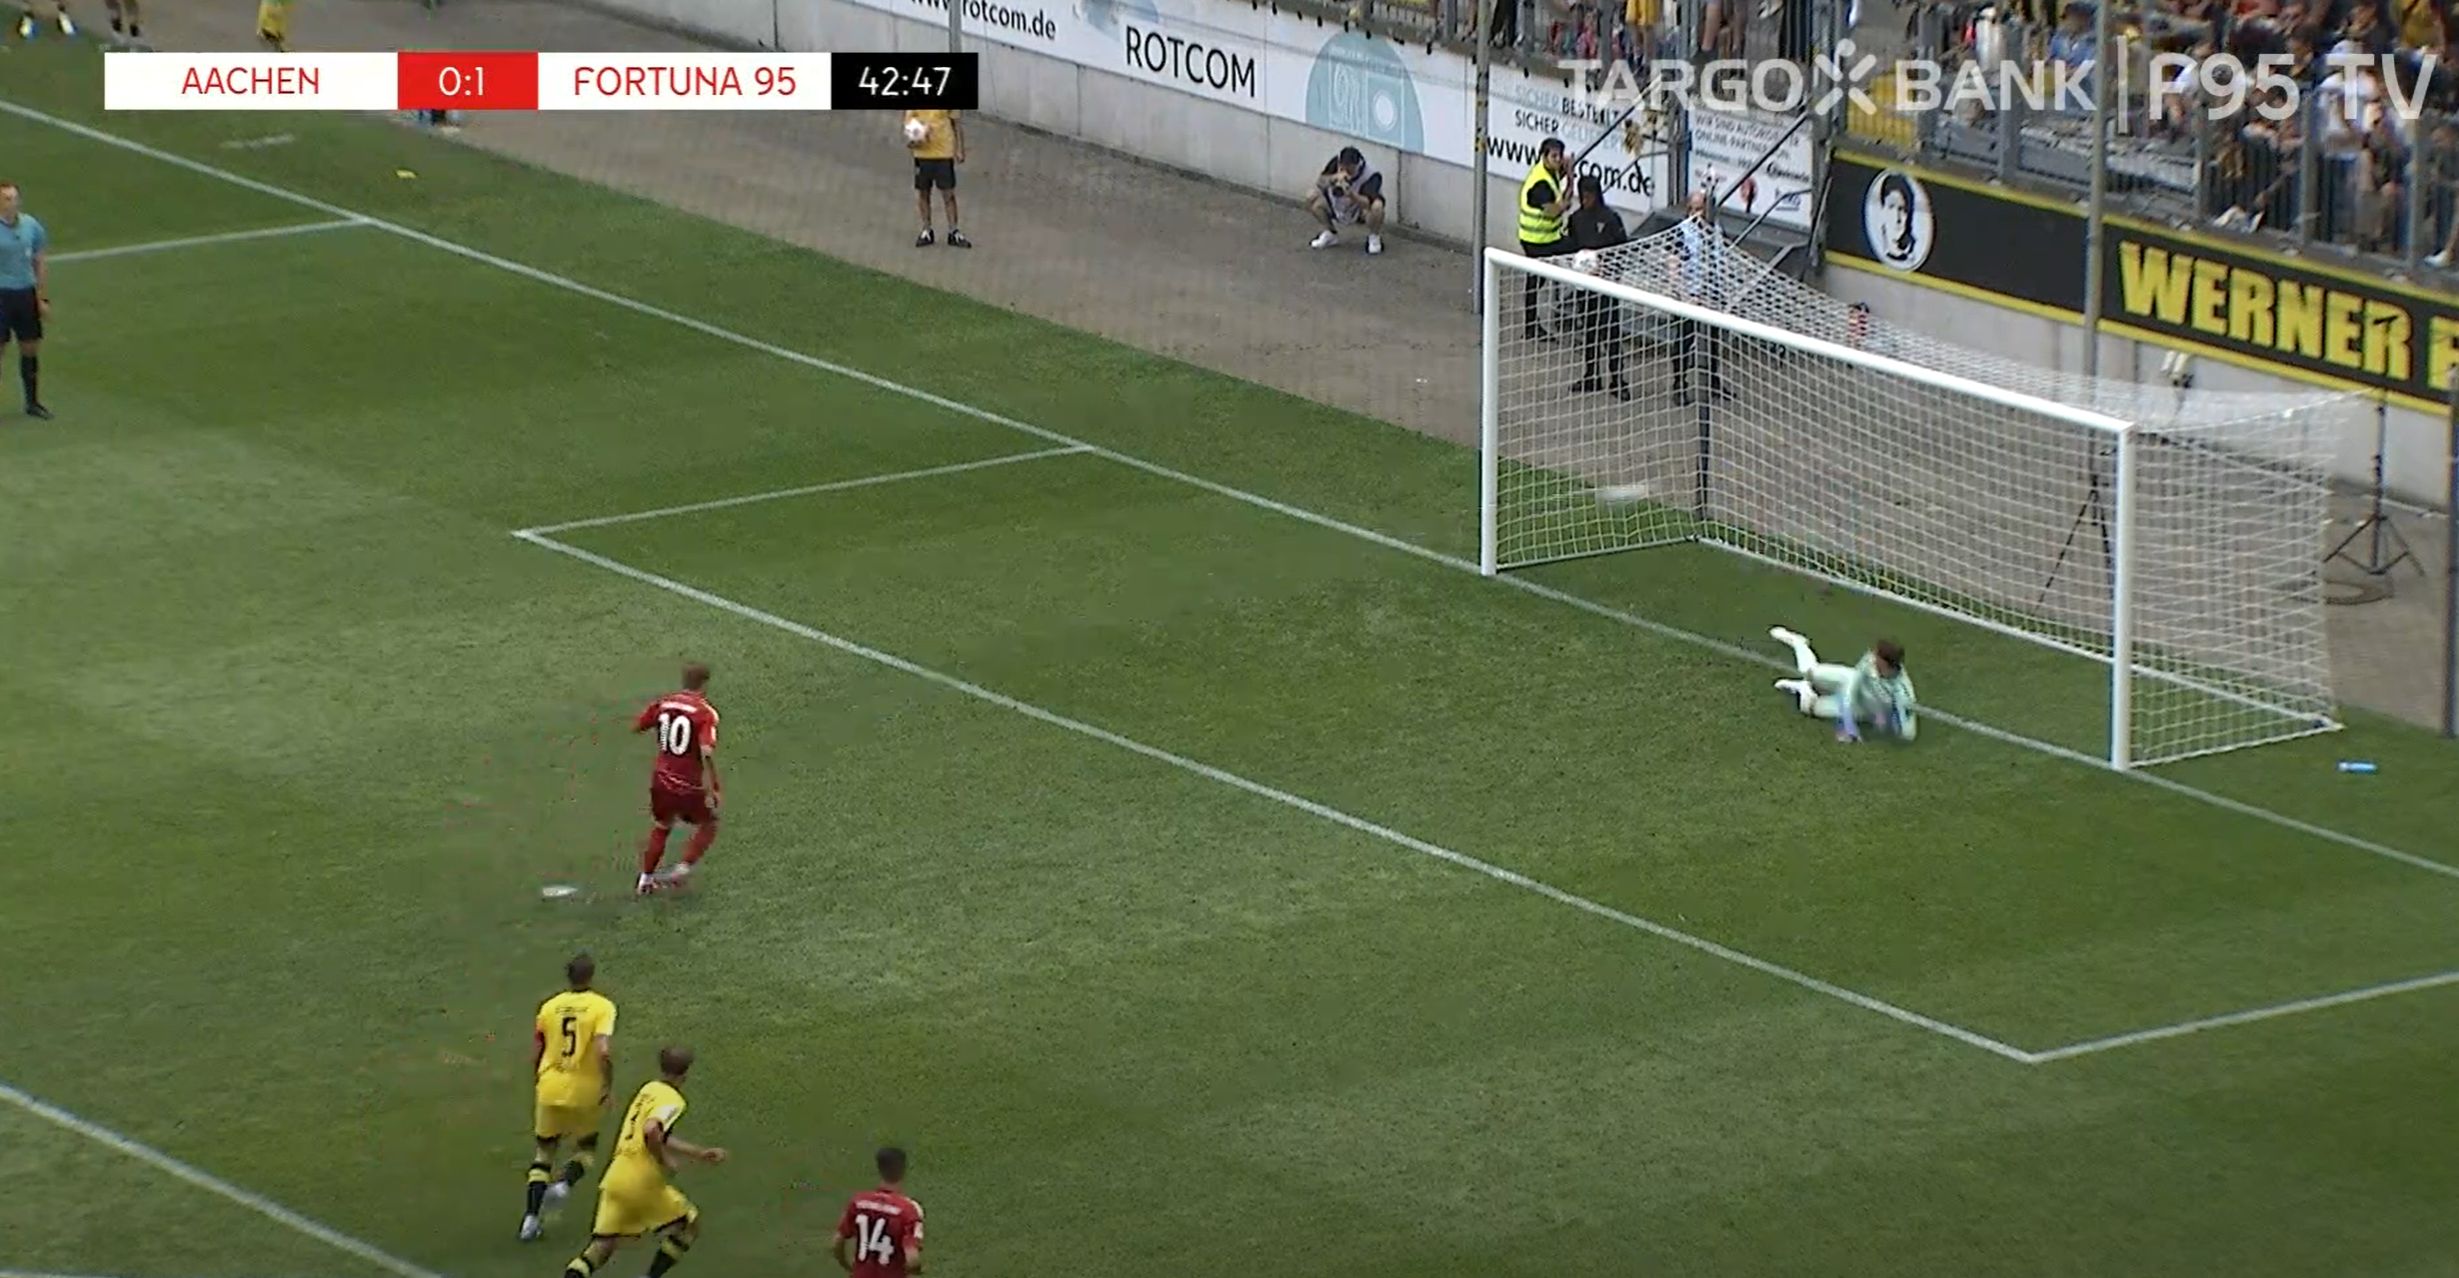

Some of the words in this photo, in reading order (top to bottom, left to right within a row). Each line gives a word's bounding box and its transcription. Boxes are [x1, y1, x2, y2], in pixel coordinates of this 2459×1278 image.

[1126, 25, 1254, 97] ROTCOM
[1514, 109, 1559, 134] SICHER
[1485, 136, 1656, 197] wwwcom.de
[2119, 240, 2412, 381] WERNER
[658, 712, 692, 756] 10
[562, 1016, 577, 1058] 5
[855, 1214, 894, 1266] 14
